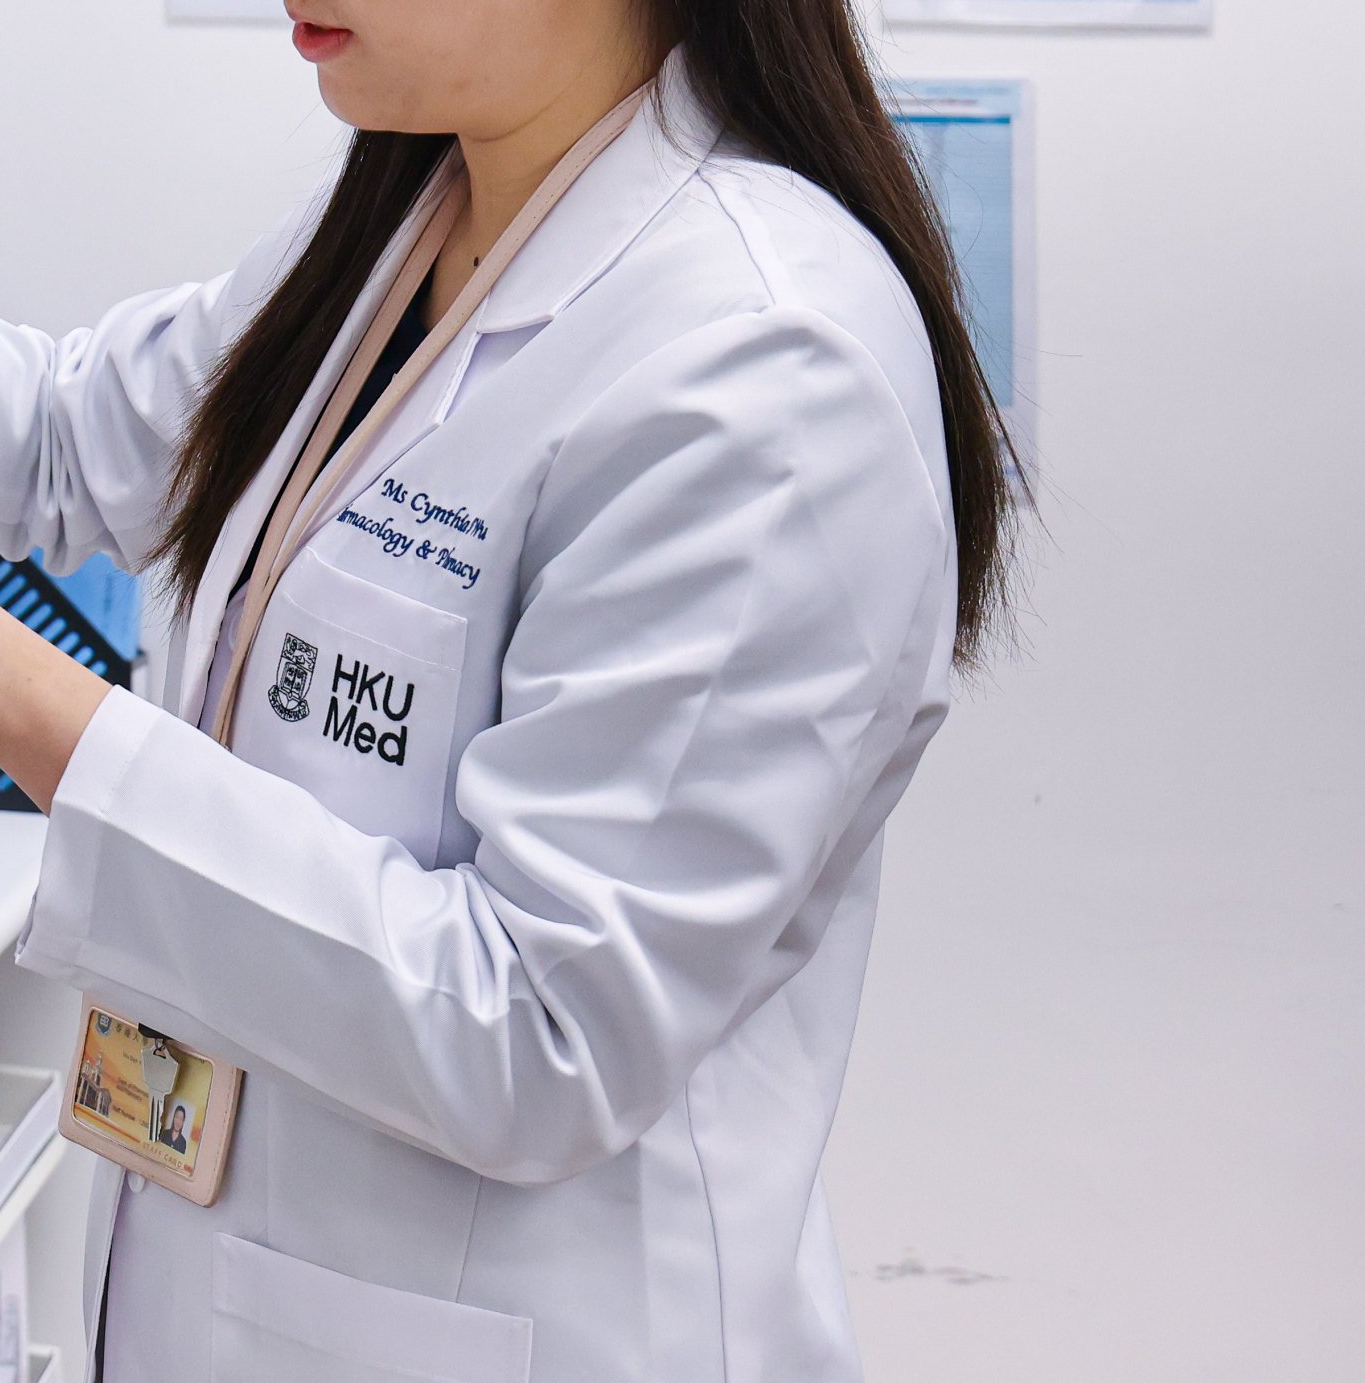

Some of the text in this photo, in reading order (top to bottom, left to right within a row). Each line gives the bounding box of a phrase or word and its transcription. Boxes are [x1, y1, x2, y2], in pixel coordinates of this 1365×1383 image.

[381, 478, 408, 504] Ms
[410, 492, 470, 534] Cynthia
[416, 540, 437, 559] &
[332, 654, 415, 722] HKU
[322, 696, 408, 767] Med
[142, 1142, 182, 1168] STAFF CARD
